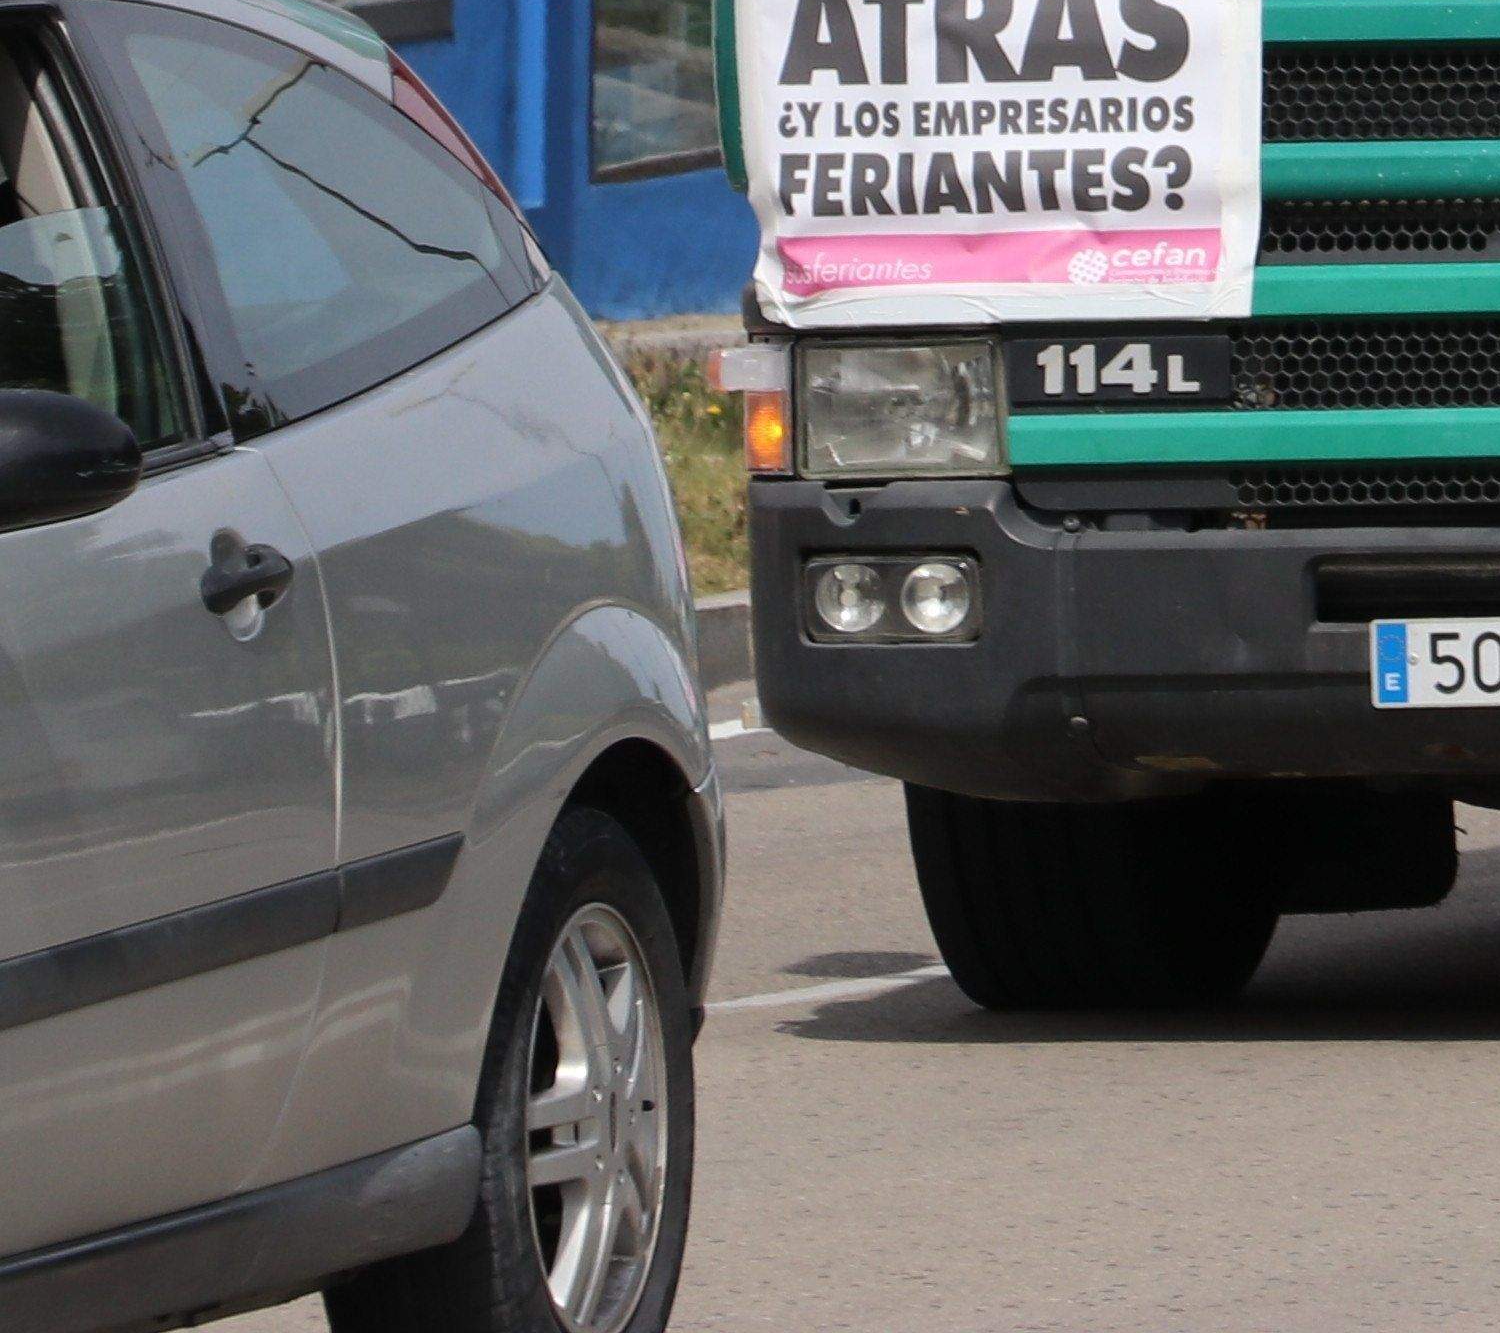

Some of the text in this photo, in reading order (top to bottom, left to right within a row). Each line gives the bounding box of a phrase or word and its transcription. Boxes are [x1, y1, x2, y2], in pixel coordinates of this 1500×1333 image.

[778, 95, 1195, 141] ¿Y LOS EMPRESARIOS
[780, 144, 1193, 218] FERIANTES?
[1110, 241, 1207, 267] cefan
[1385, 673, 1402, 691] E
